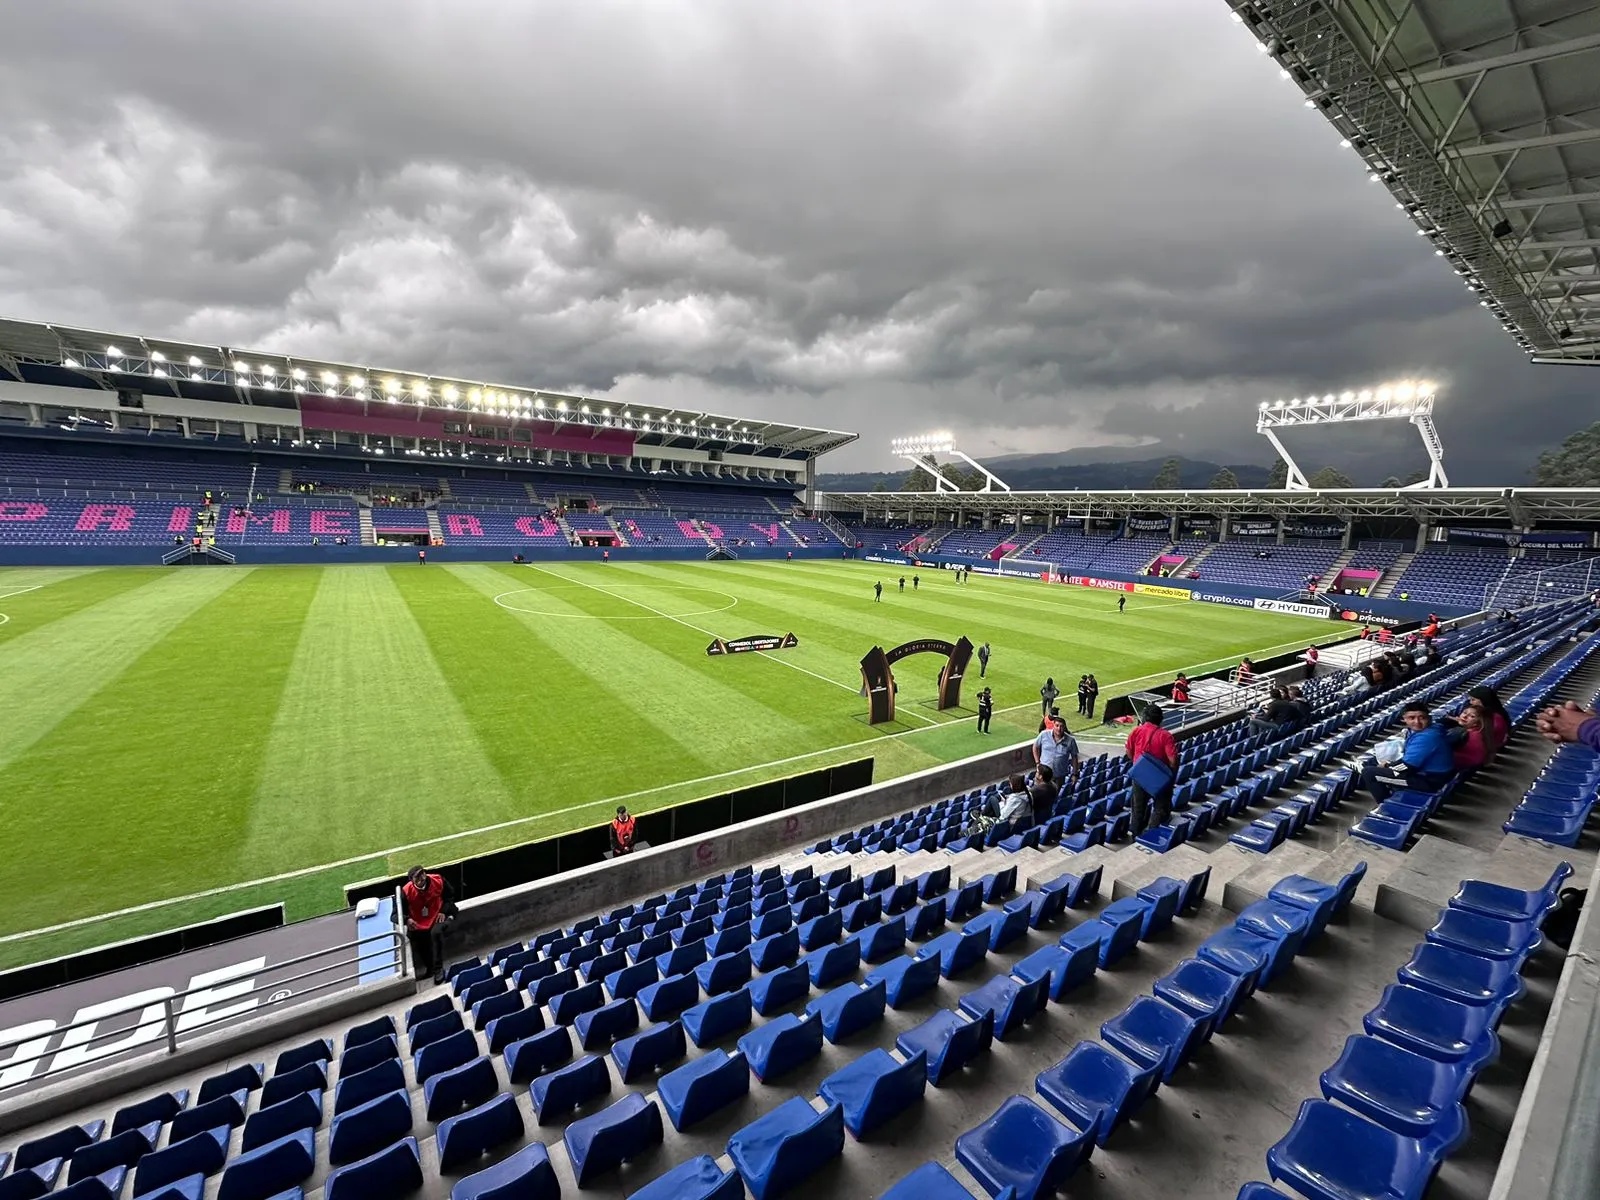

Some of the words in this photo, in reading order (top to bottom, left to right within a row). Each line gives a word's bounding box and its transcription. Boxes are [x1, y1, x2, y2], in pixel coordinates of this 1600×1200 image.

[1096, 579, 1127, 591] AMSTEL
[1145, 587, 1173, 595] mercado
[1174, 588, 1189, 598] libre
[1203, 593, 1253, 607] crypto.com
[1278, 603, 1328, 616] HYUNDAI
[1359, 614, 1399, 625] priceless
